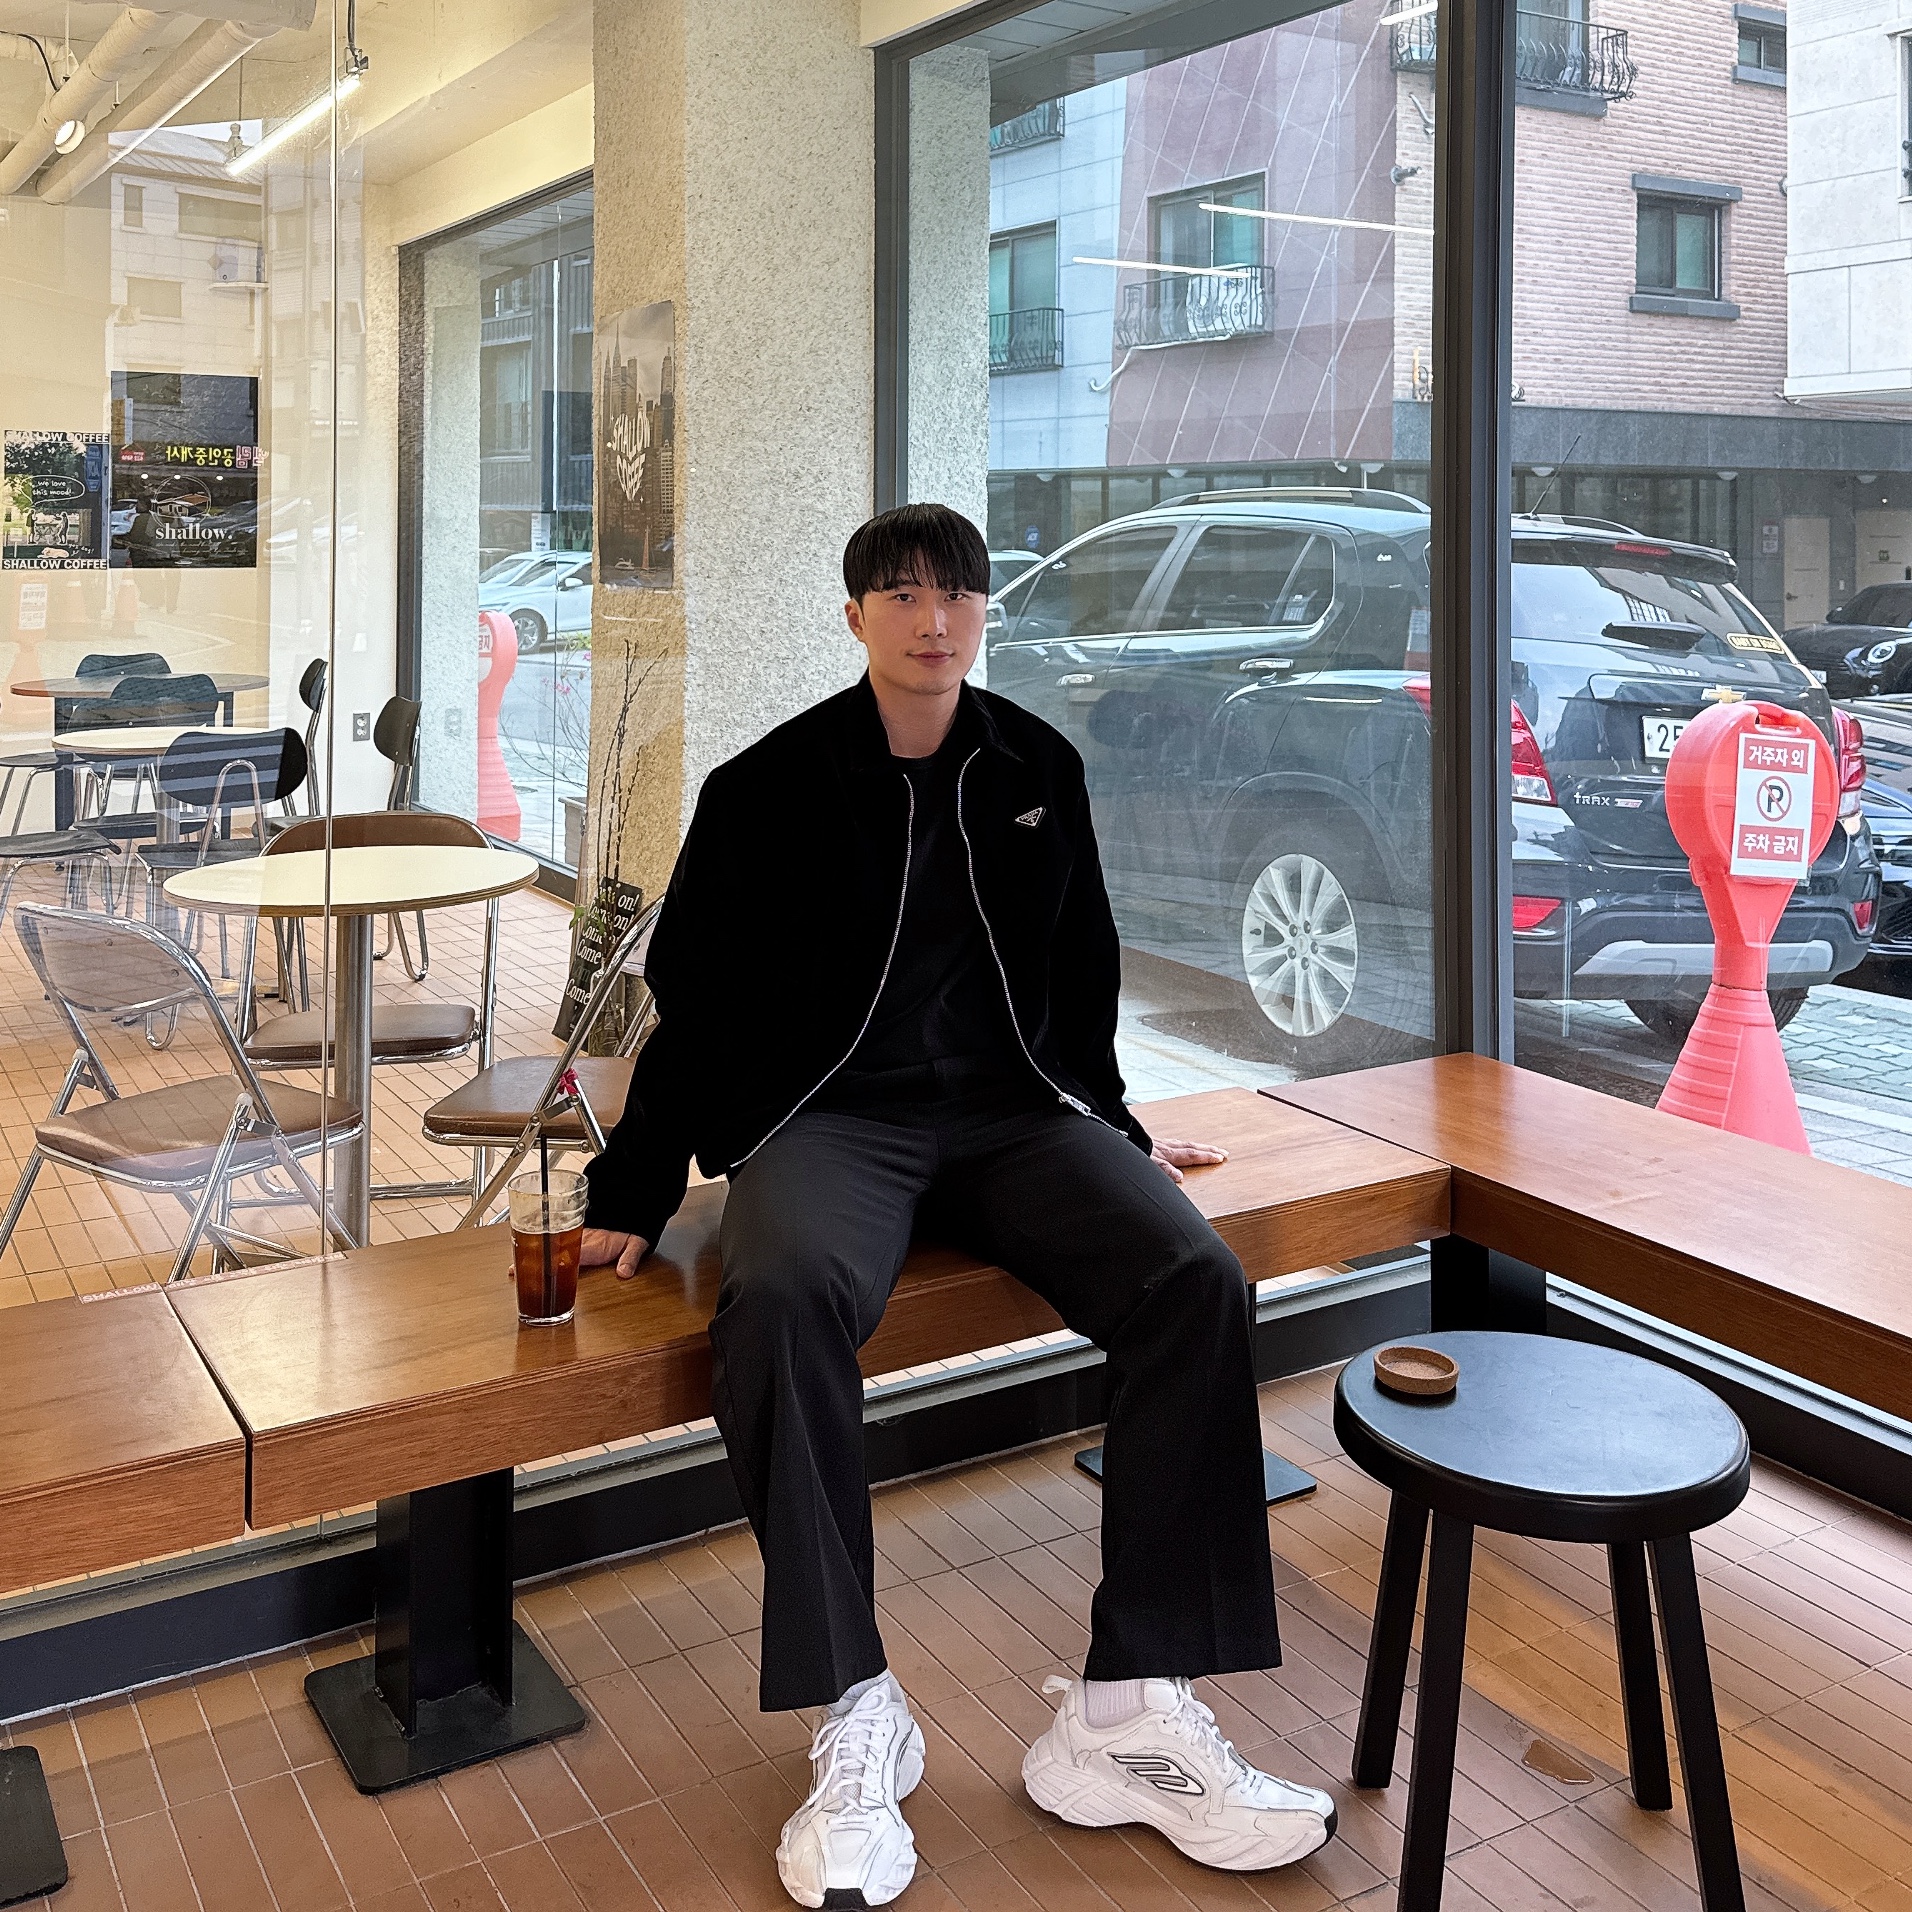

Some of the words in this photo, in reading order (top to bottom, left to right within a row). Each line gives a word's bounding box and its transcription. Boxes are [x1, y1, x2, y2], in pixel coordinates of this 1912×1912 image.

[66, 432, 109, 443] COFFEE
[3, 559, 61, 569] SHALLOW
[63, 559, 107, 569] COFFEE
[1748, 745, 1788, 767] 거주자
[1790, 749, 1805, 769] 외
[1743, 833, 1770, 854] 주차
[1772, 835, 1799, 856] 금지
[617, 893, 640, 912] on!
[576, 938, 602, 965] Come
[565, 978, 592, 1005] Come
